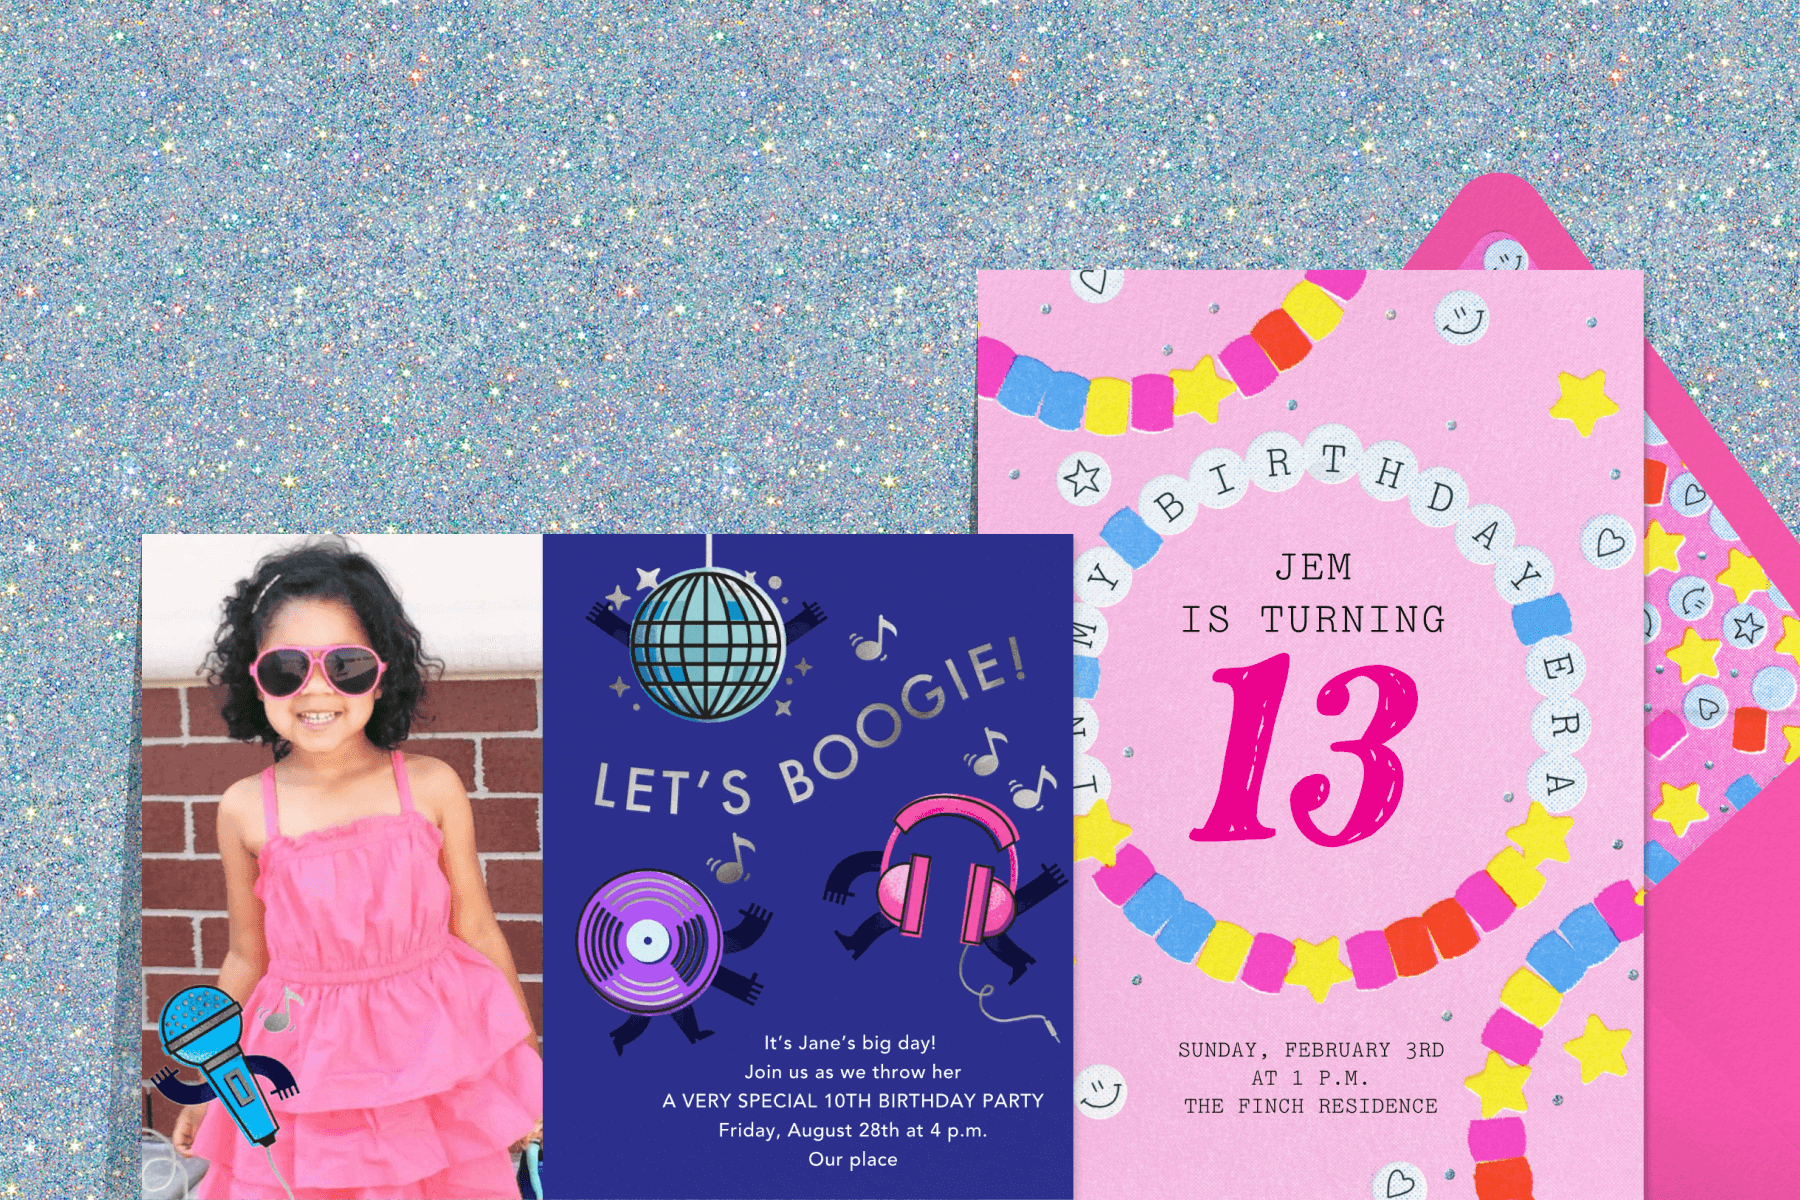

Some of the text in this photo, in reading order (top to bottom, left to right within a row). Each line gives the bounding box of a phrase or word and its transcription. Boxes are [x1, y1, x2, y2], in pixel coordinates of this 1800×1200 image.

[1275, 553, 1351, 581] JEM
[1152, 443, 1543, 591] BIRTHDAY
[1542, 651, 1581, 797] ERA
[1182, 605, 1445, 633] IS TURNING
[594, 636, 1026, 815] LET’S BOOGIE!
[1189, 652, 1419, 848] 13
[765, 1033, 936, 1055] It’s Jane’s big day!
[1178, 1042, 1444, 1061] SUNDAY, FEBRUARY 3RD
[744, 1063, 962, 1080] Join us as we throw her
[1251, 1070, 1367, 1086] AT 1 P.M.
[662, 1092, 1045, 1109] A VERY SPECIAL 10TH BIRTHDAY PARTY
[1184, 1098, 1438, 1114] THE FINCH RESIDENCE
[719, 1121, 987, 1143] Friday, August 28th at 4 p.m.
[808, 1150, 898, 1172] Our place
